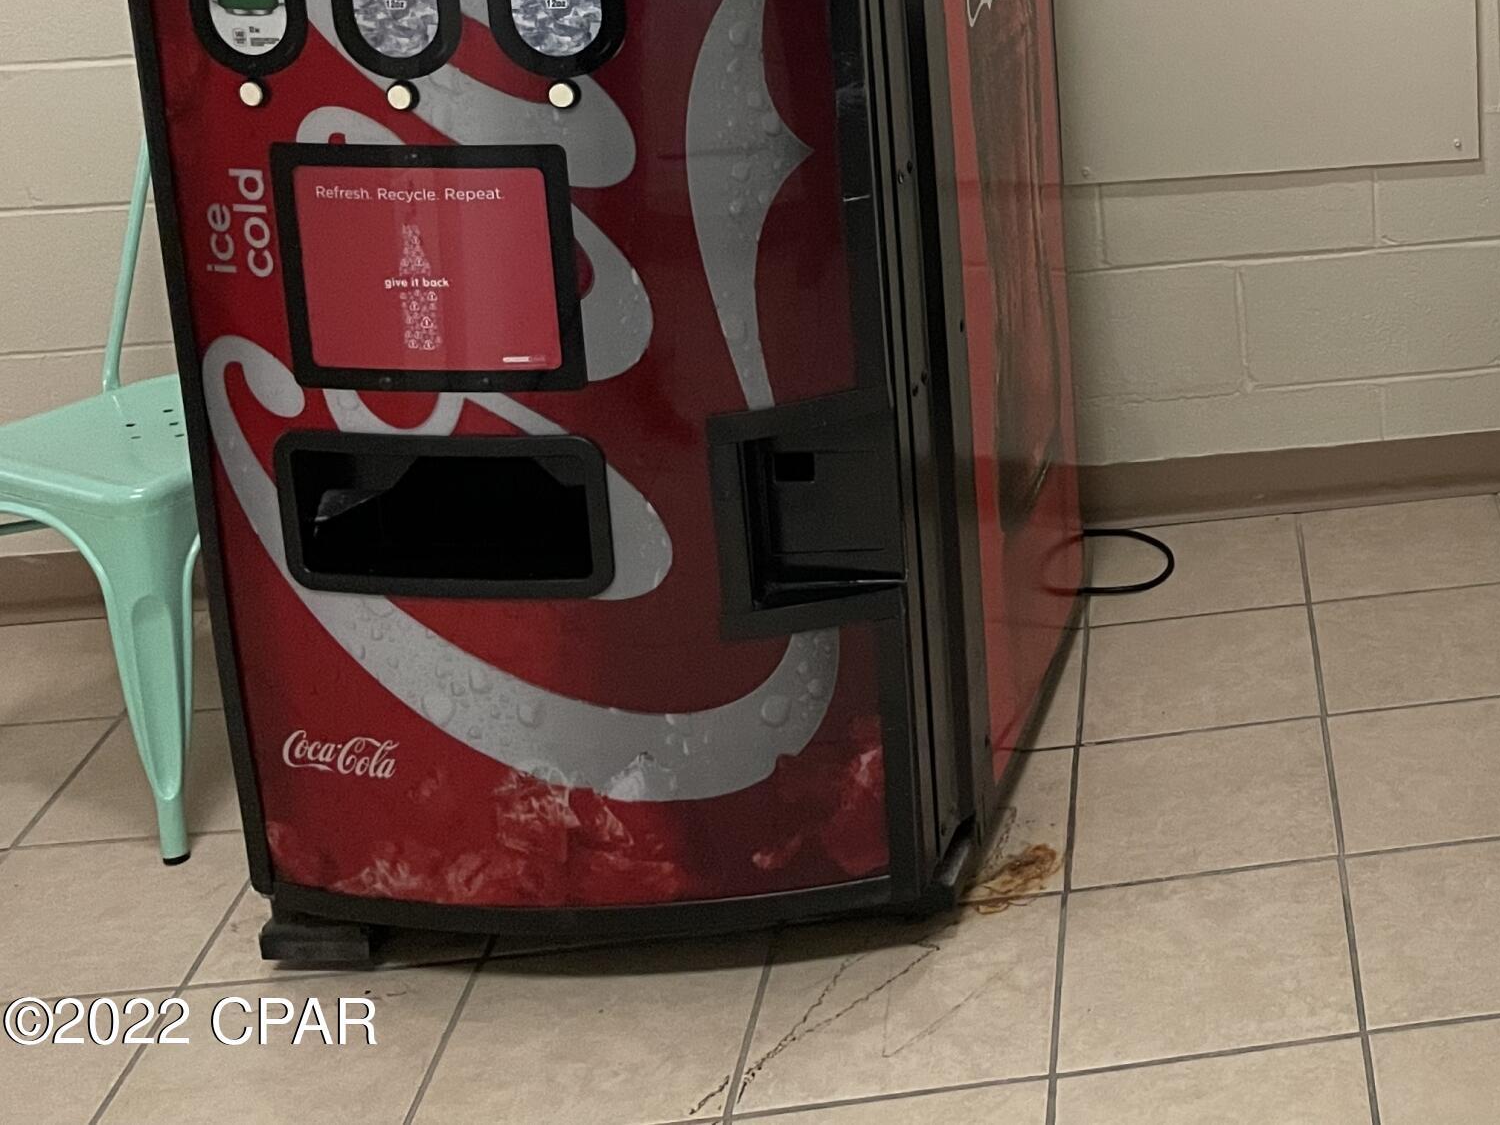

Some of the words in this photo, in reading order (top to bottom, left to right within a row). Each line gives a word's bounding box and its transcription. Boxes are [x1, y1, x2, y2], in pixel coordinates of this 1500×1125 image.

[546, 0, 567, 9] 12oz
[316, 185, 371, 200] Refresh.
[377, 187, 439, 204] Recycle.
[445, 187, 505, 202] Repeat.
[207, 202, 237, 273] ice
[229, 169, 274, 277] cold
[384, 277, 408, 289] give
[411, 277, 419, 287] it
[422, 277, 450, 288] back
[283, 730, 400, 779] Coca-Cola
